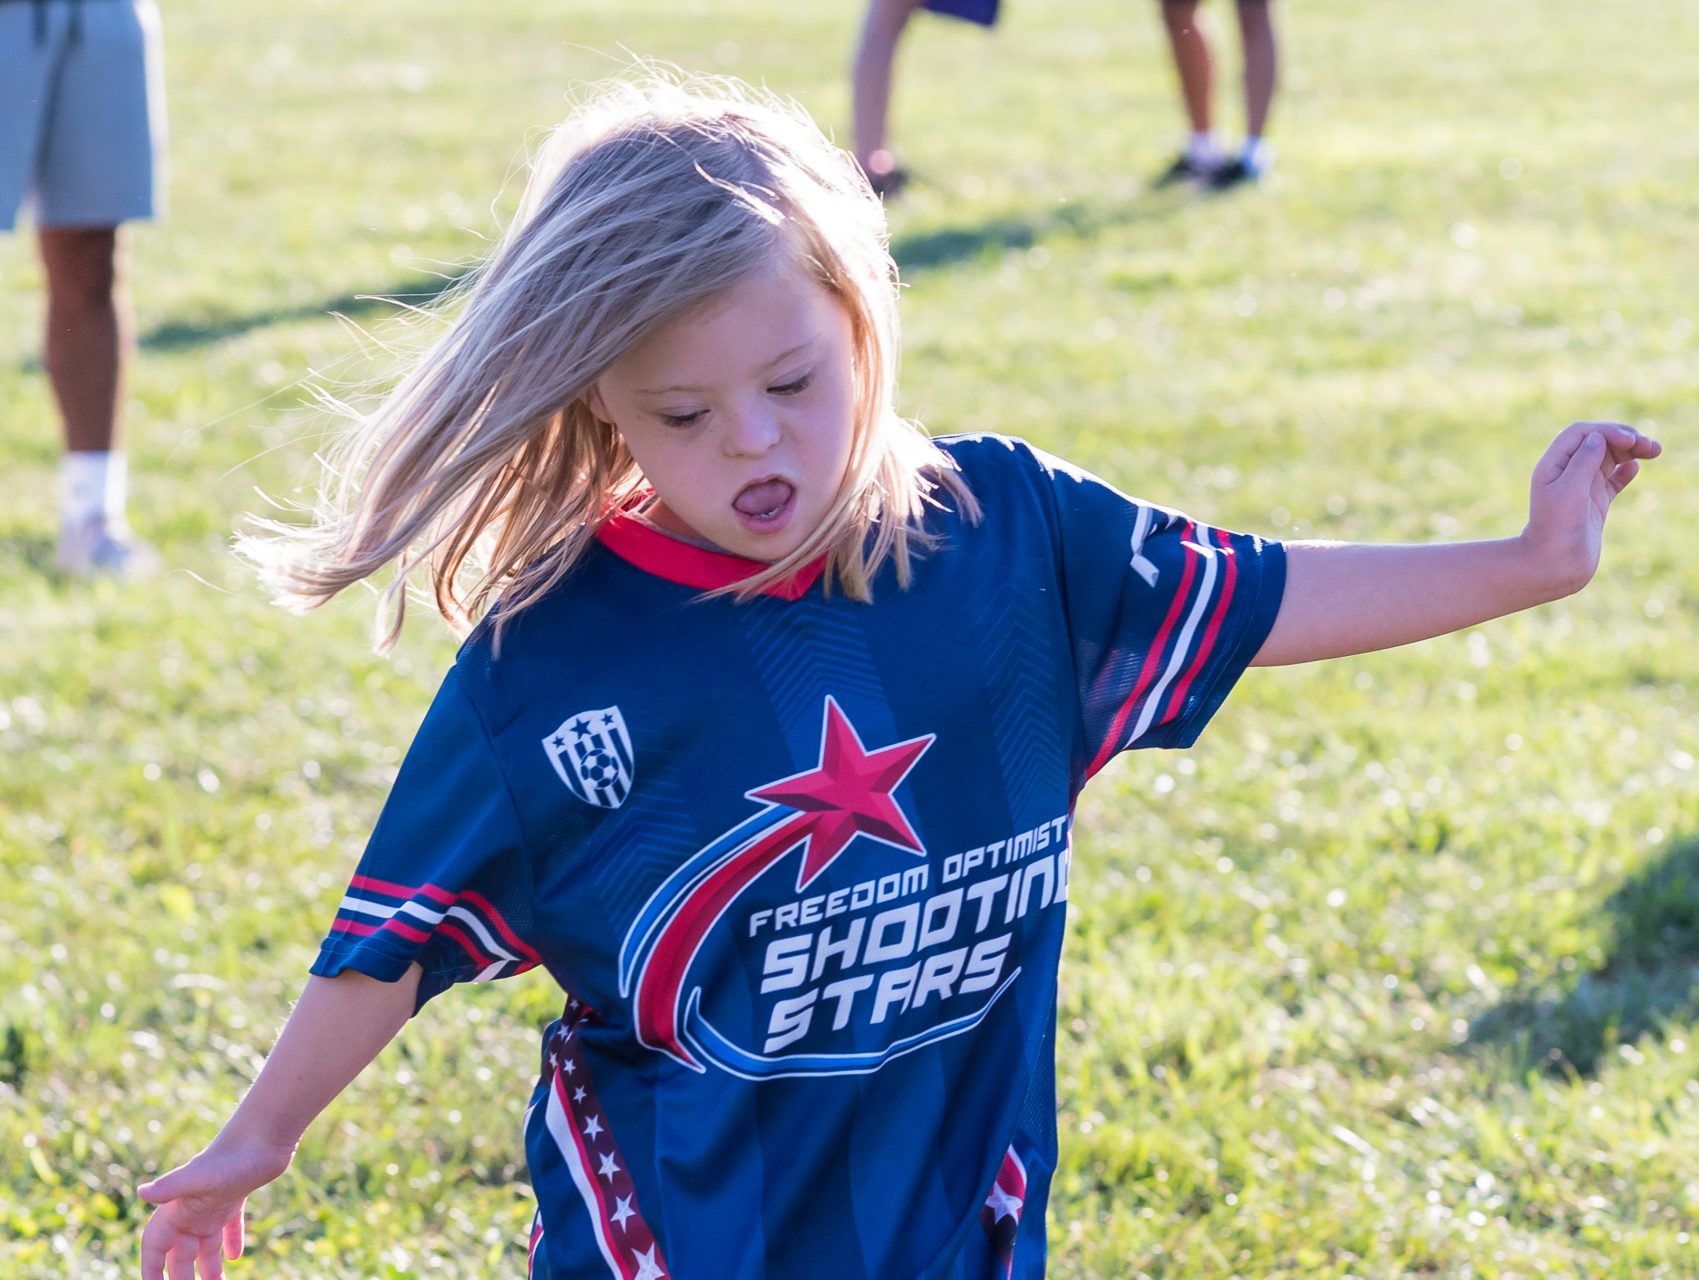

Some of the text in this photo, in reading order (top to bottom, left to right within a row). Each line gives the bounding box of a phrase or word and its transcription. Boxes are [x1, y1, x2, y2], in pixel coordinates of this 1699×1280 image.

[749, 815, 1068, 938] FREEDOM OPTIMIST
[763, 933, 1012, 1054] STARS
